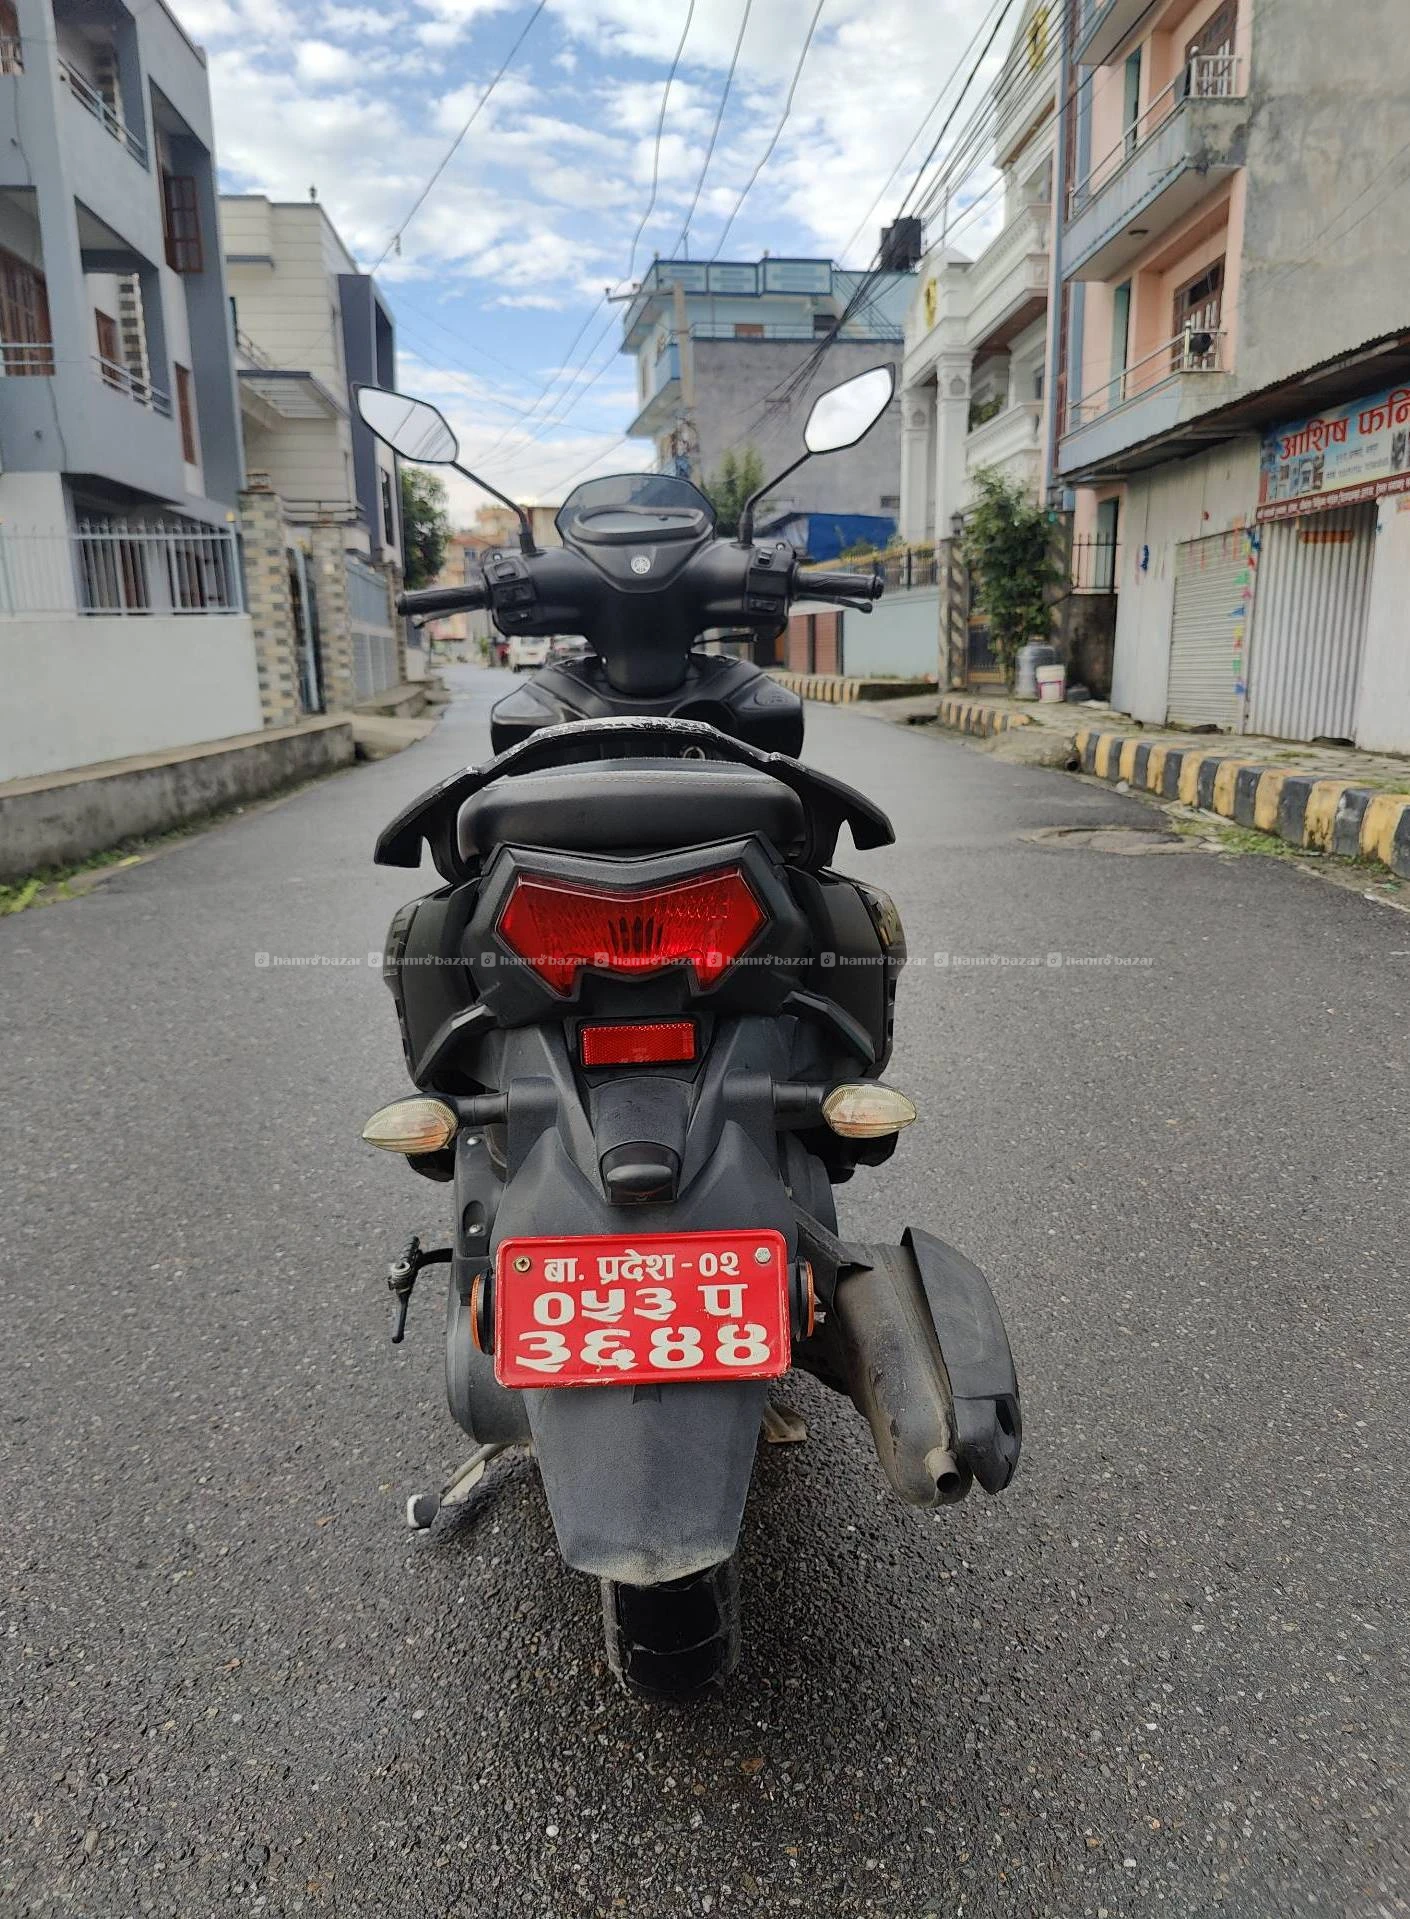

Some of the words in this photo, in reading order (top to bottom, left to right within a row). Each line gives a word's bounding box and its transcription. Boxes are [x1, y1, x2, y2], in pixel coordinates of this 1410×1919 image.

[1280, 418, 1350, 460] आशिष
[544, 1257, 585, 1283] बा.
[533, 1287, 677, 1326] ०५३
[697, 1283, 749, 1318] प
[515, 1323, 771, 1373] ३६४४
